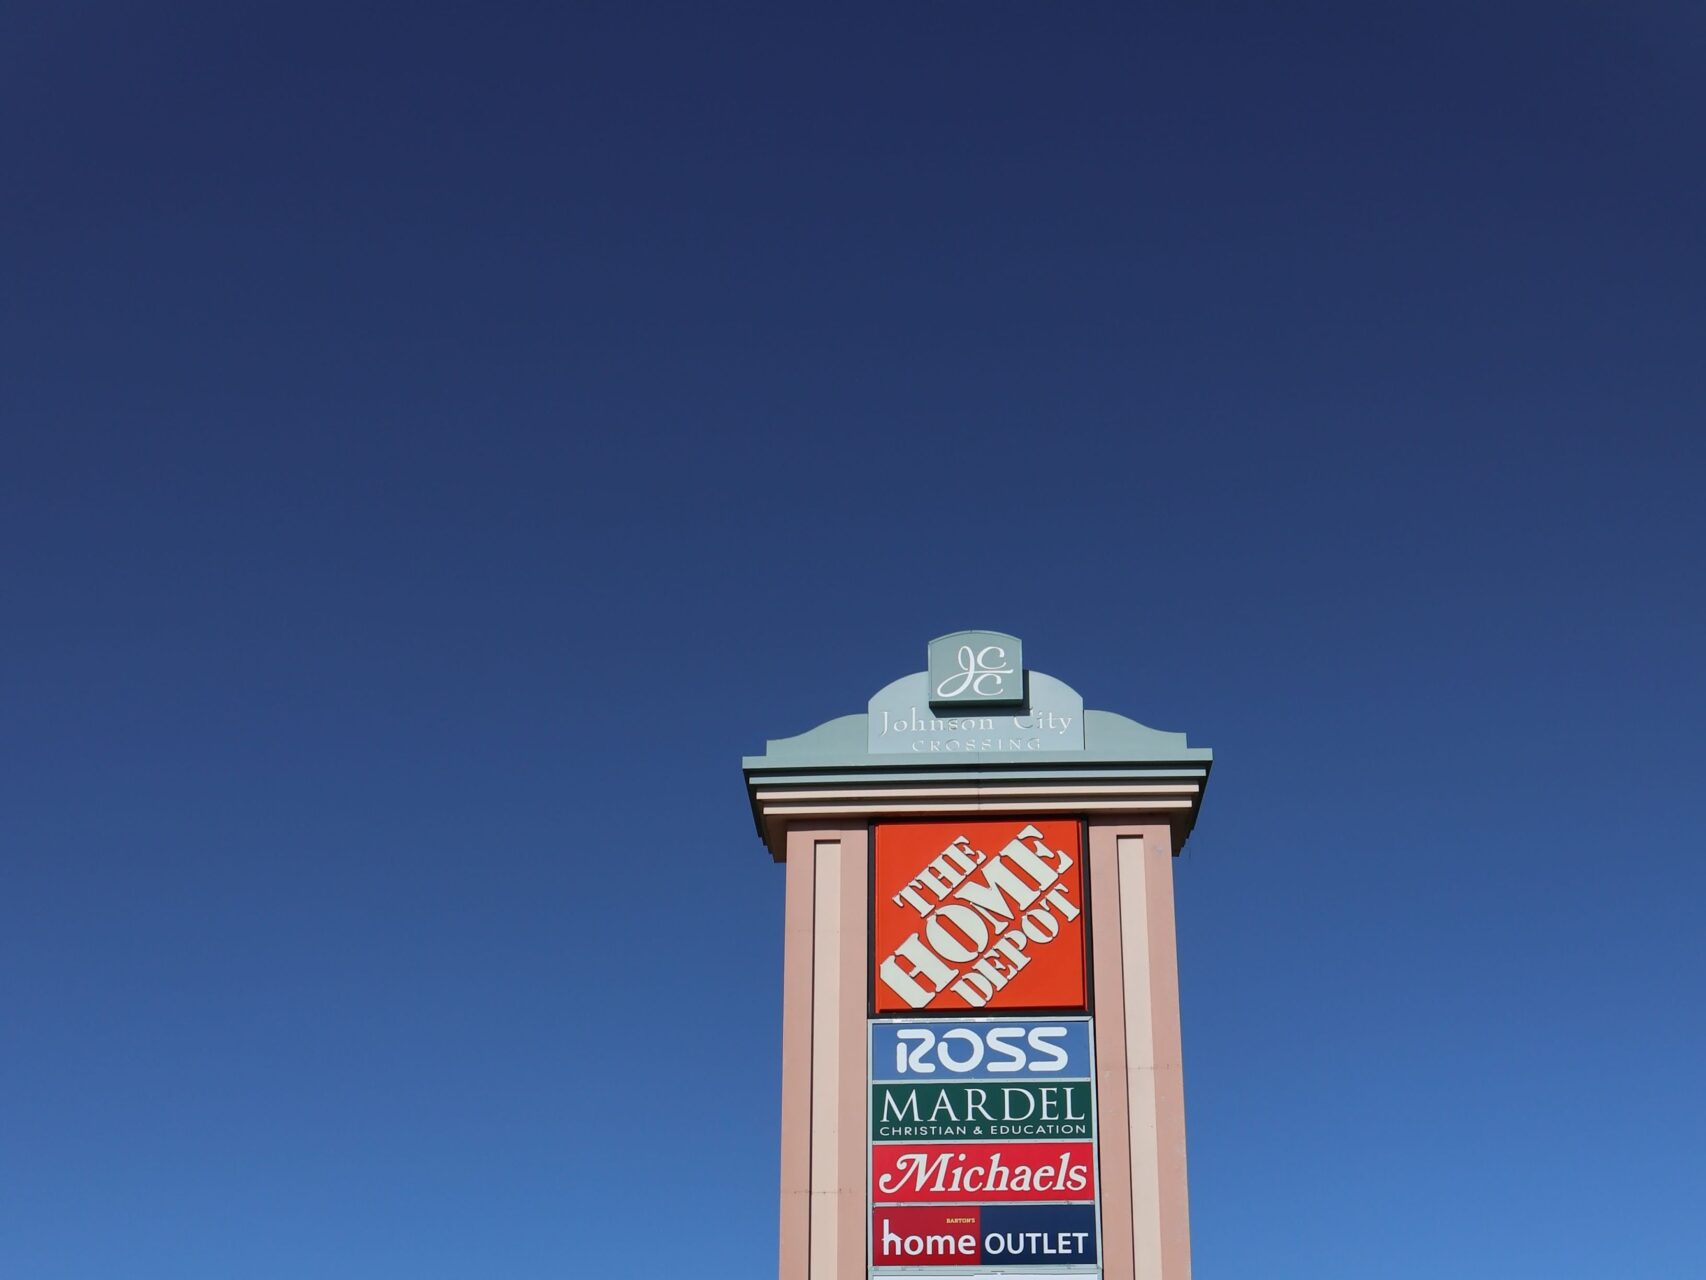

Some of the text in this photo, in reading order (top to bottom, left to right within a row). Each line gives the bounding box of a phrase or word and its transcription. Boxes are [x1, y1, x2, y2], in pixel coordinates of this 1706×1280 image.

[880, 706, 1072, 736] Johnson City
[912, 737, 1040, 751] CROSSING
[892, 835, 987, 918] THE
[880, 824, 1074, 1009] HOME
[951, 883, 1081, 1008] DEPOT
[896, 1026, 1069, 1074] ROSS
[880, 1087, 1086, 1122] MARDEL
[879, 1124, 1086, 1136] CHRISTIAN & EDUCATION
[878, 1152, 1087, 1194] Michaels
[881, 1219, 1089, 1256] home OUTLET
